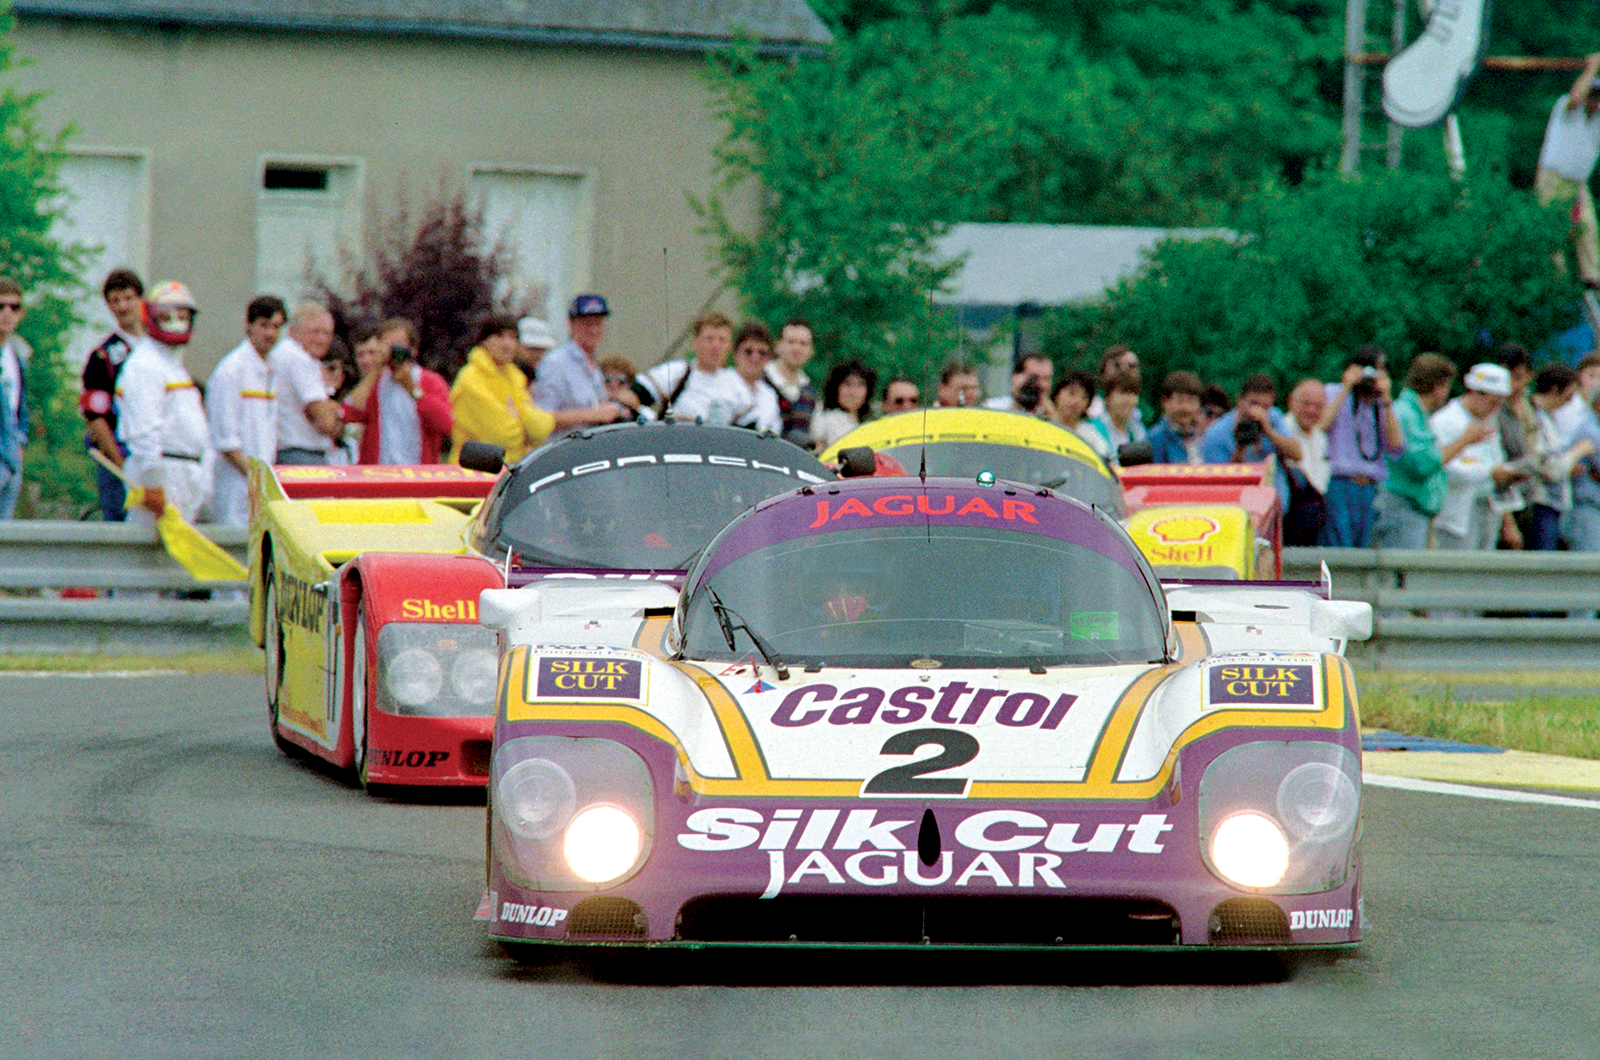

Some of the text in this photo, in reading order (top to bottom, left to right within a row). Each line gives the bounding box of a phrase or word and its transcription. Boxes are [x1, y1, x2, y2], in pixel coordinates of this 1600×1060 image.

[810, 495, 1038, 528] JAGUAR
[1151, 545, 1213, 563] Shell
[402, 598, 477, 620] Shell
[550, 660, 630, 675] SILK
[1221, 667, 1301, 681] SILK
[555, 674, 623, 690] CUT
[1226, 681, 1294, 697] CUT
[770, 681, 1079, 730] Castrol
[864, 728, 980, 794] 2
[677, 808, 1174, 854] Silk Cut
[759, 850, 1067, 900] JAGUAR
[501, 902, 568, 927] DUNLOP
[1289, 909, 1354, 930] DUNLOP
